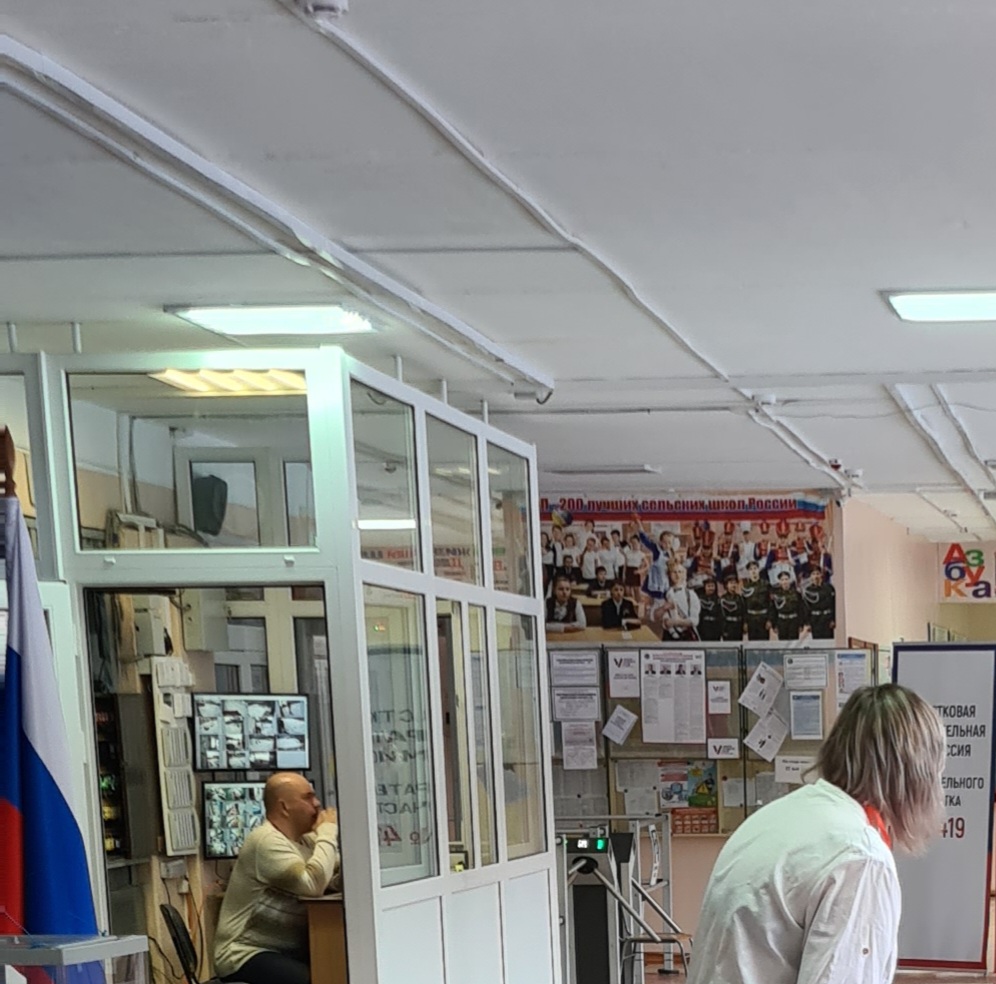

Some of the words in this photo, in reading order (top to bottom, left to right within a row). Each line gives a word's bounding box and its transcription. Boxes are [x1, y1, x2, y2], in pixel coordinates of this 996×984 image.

[587, 500, 639, 511] лучших
[641, 500, 705, 511] сельских
[708, 499, 745, 510] школ
[748, 497, 797, 510] России
[932, 705, 976, 718] ТКОВАЯ
[945, 724, 986, 738] ЕЛЬНАЯ
[941, 777, 984, 789] ЕЛЬНОГО
[945, 794, 961, 806] ТКА
